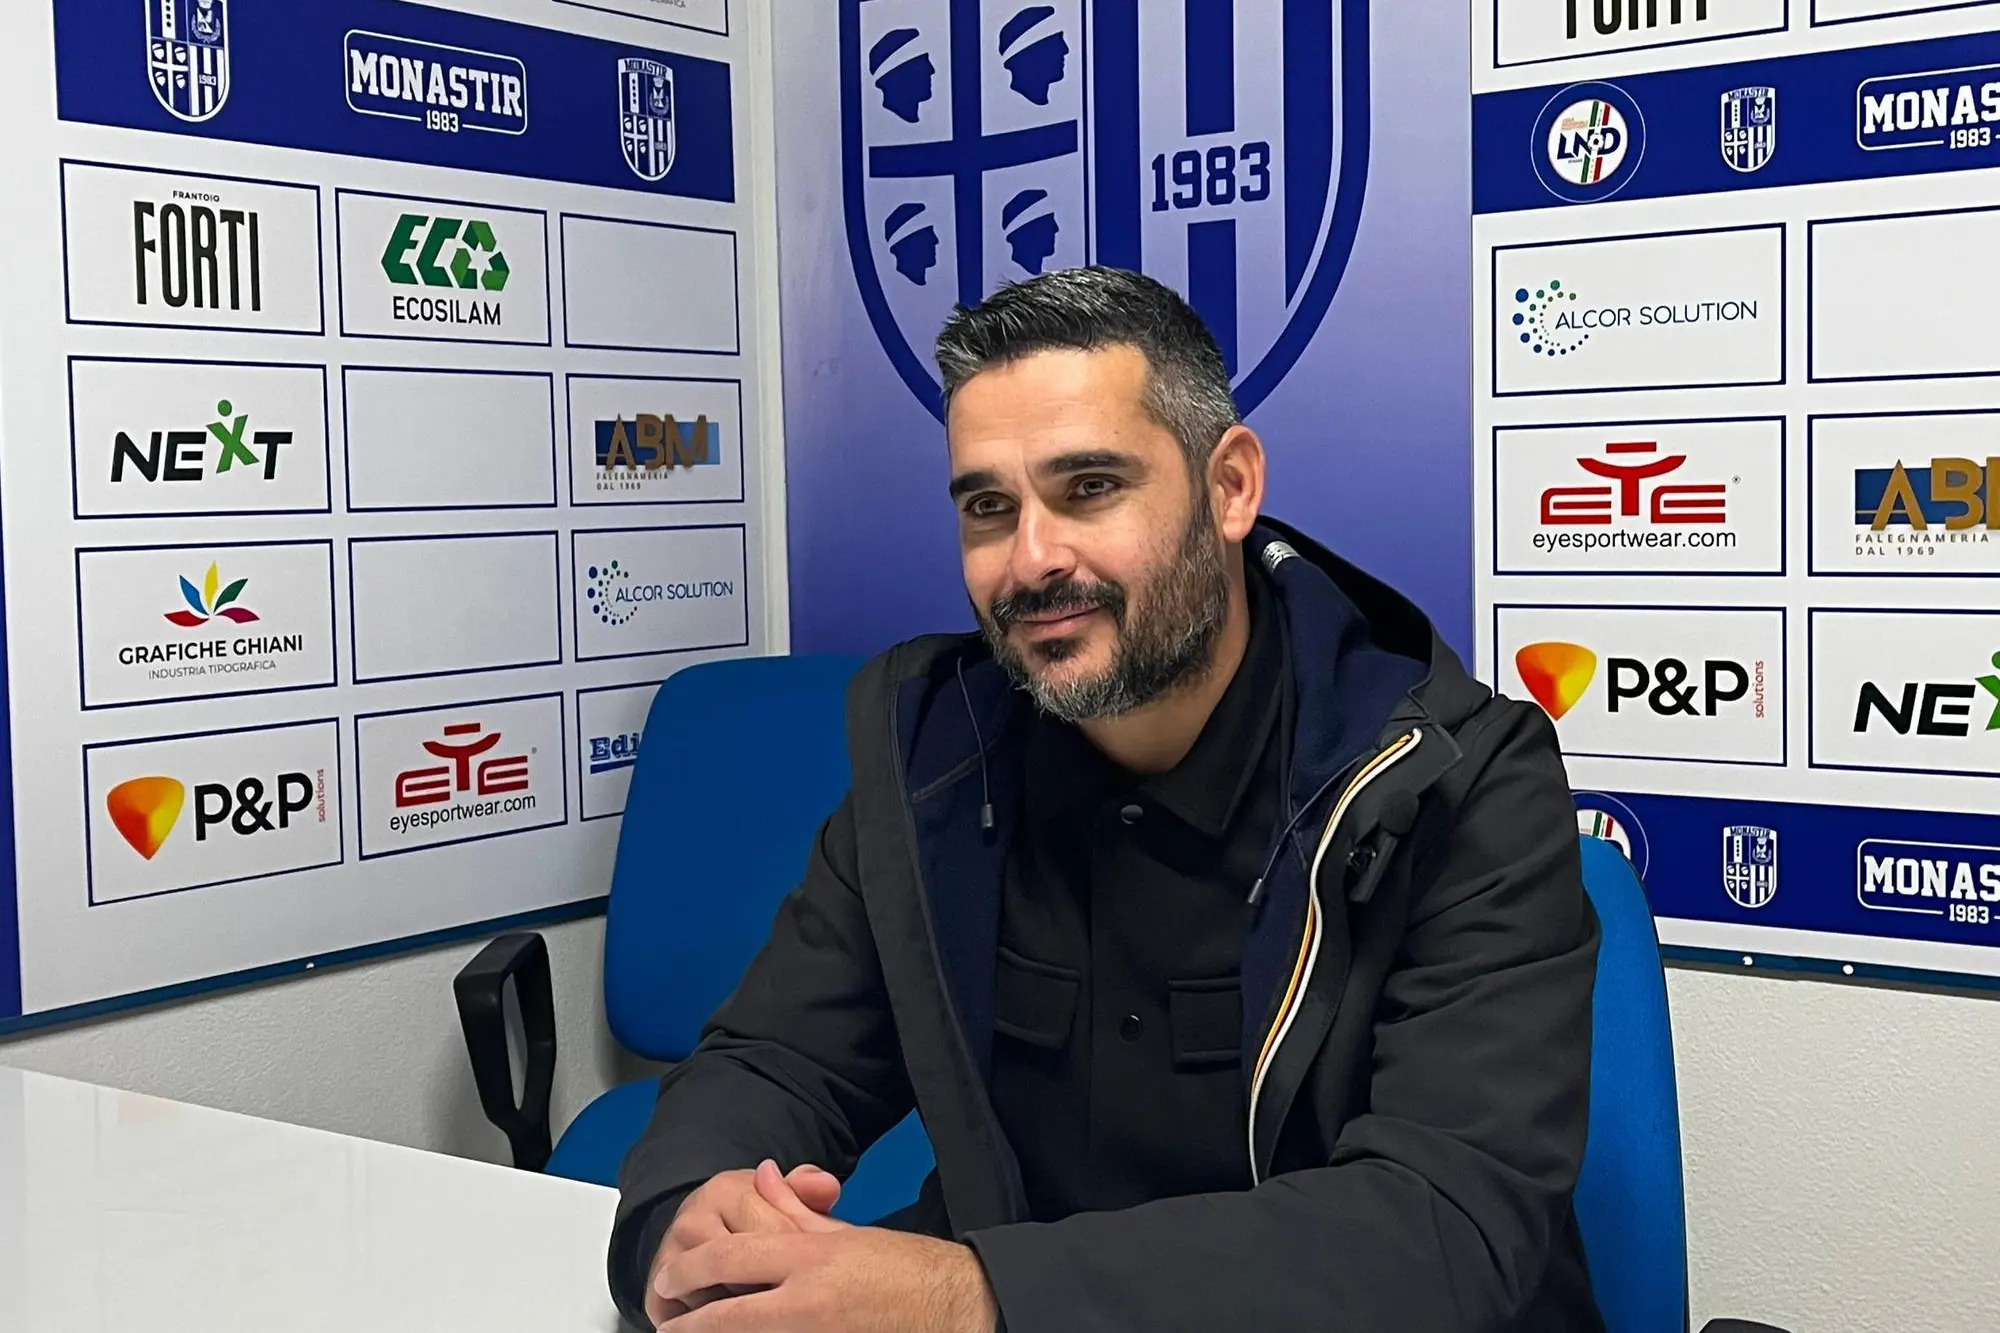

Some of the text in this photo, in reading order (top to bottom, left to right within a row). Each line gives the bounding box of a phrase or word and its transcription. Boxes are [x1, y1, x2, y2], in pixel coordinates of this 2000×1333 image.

[350, 49, 522, 117] MONASTIR
[426, 109, 459, 133] 1983
[1949, 127, 1991, 149] 1983
[1151, 141, 1271, 212] 1983
[172, 190, 220, 202] FRANTOIO
[134, 201, 261, 311] FORTI
[392, 296, 501, 325] ECOSILAM
[1555, 300, 1757, 330] ALCOR SOLUTION
[110, 400, 293, 483] NEXT
[605, 412, 708, 471] ABM
[1870, 457, 2000, 531] AB
[1533, 529, 1736, 553] eyesportwear.com
[1855, 534, 1989, 543] FALEGNAMERIA
[1855, 547, 1935, 555] DAL 1969
[615, 581, 733, 603] ALCOR SOLUTION
[118, 634, 303, 665] GRAFICHE GHIANI
[149, 660, 276, 680] INDUSTRIA TIPOGRAFICA
[1607, 658, 1749, 716] P&P
[1752, 660, 1764, 718] solutions
[194, 772, 313, 841] P&P
[315, 769, 326, 822] solutions
[390, 795, 537, 834] eyesportwear.com
[1949, 903, 1989, 924] 1983
